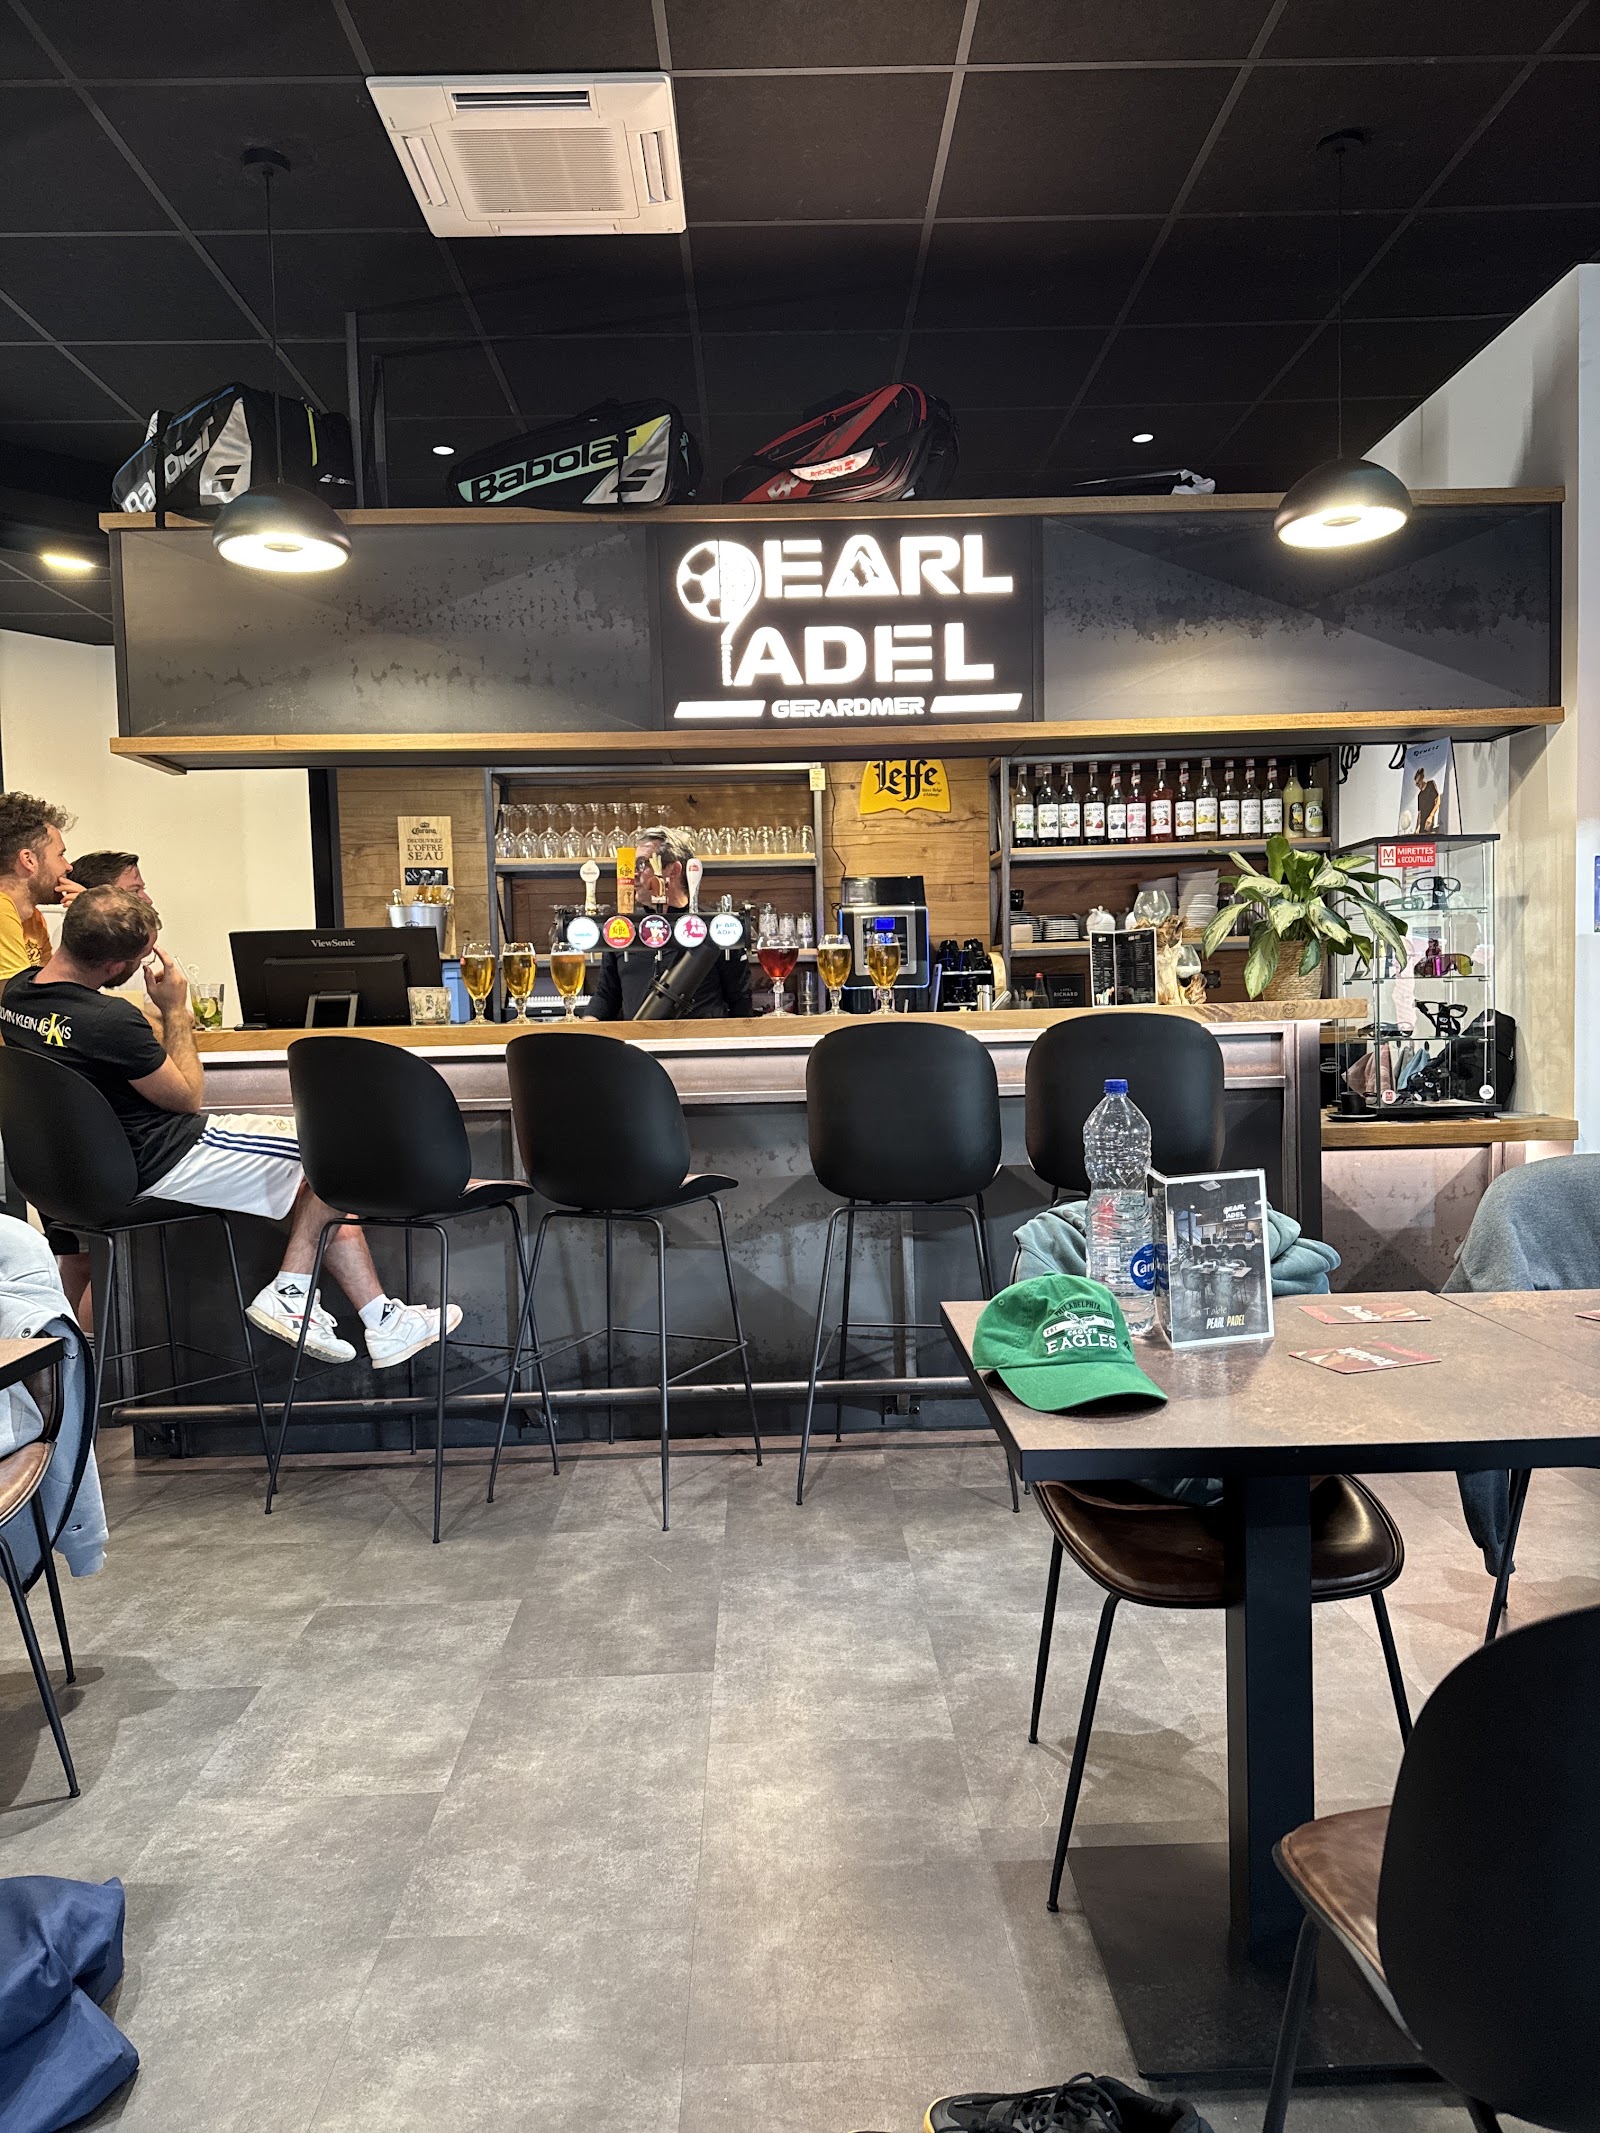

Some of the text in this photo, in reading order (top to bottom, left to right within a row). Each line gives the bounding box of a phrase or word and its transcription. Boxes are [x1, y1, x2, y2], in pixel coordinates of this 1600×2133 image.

[121, 416, 215, 512] Baolat
[471, 429, 637, 502] Babolat
[771, 697, 925, 718] GERARDMER
[873, 759, 938, 802] Leffe
[407, 844, 443, 852] L'OFFRE
[408, 851, 444, 861] SEAU
[1397, 847, 1434, 856] MIRETTES
[1401, 855, 1434, 864] ECOUTILLES
[310, 938, 356, 948] ViewSonic
[15, 1012, 38, 1032] KLEIN
[1054, 1300, 1101, 1317] PHILADELPHIA
[1203, 1305, 1228, 1316] Table
[1206, 1314, 1246, 1330] PEARL PADEL
[1045, 1333, 1118, 1355] EAGLES
